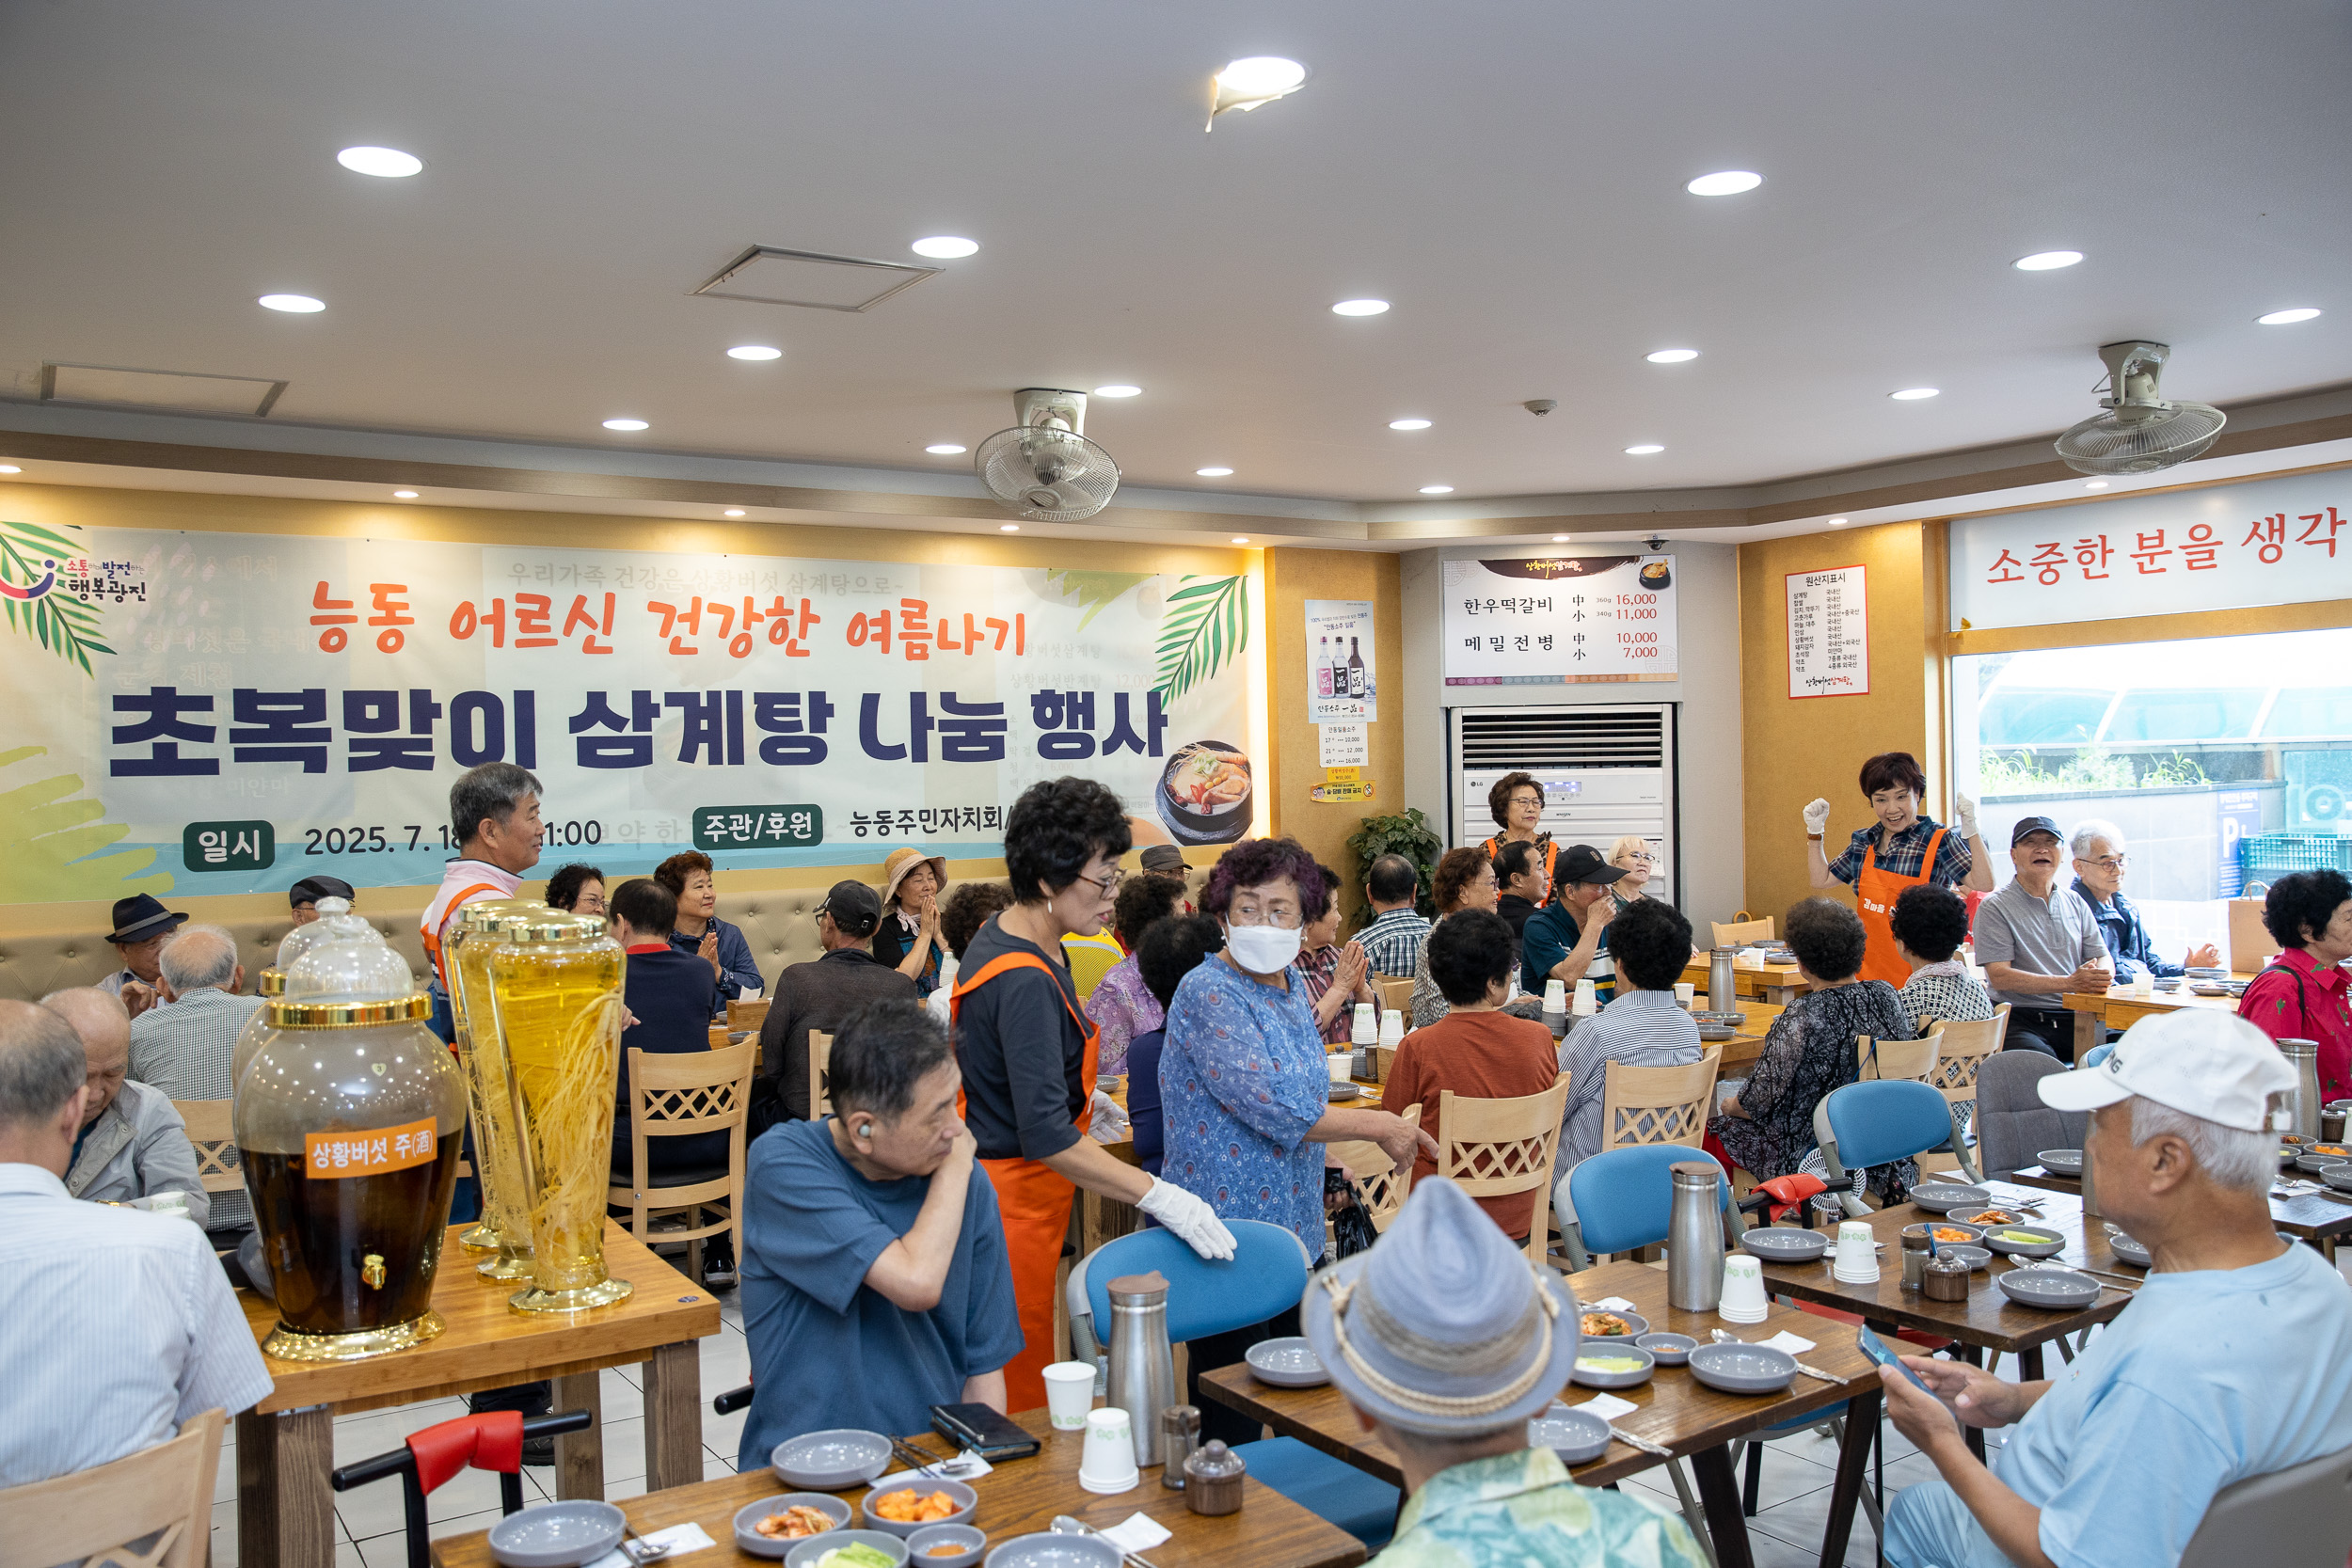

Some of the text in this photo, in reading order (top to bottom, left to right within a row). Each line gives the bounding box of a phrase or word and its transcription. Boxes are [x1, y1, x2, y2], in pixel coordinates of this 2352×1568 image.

[1987, 506, 2347, 585] 소중한 분을 생각
[69, 578, 146, 603] 행복광진
[1805, 572, 1846, 587] 원산지표시
[1464, 596, 1552, 615] 한우떡갈비
[1572, 594, 1584, 607] 中
[1615, 594, 1657, 606] 16,000
[1572, 610, 1585, 622] 小
[1615, 609, 1657, 621] 11,000
[310, 580, 415, 654] 능동
[449, 592, 616, 655] 어르신
[647, 595, 821, 658] 건강한
[846, 597, 1025, 661] 여름나기
[1573, 632, 1585, 644] 中
[1616, 632, 1658, 644] 10,000
[1573, 646, 1658, 660] 小 7,000
[110, 686, 537, 777] 초복맞이
[568, 689, 835, 768] 삼계탕
[858, 691, 1009, 763] 나눔
[1030, 689, 1168, 760] 행사
[199, 829, 261, 863] 일시
[541, 819, 602, 848] 1:00
[703, 811, 813, 843] 주관/후원
[312, 1130, 433, 1168] 상황버섯 주(酒)
